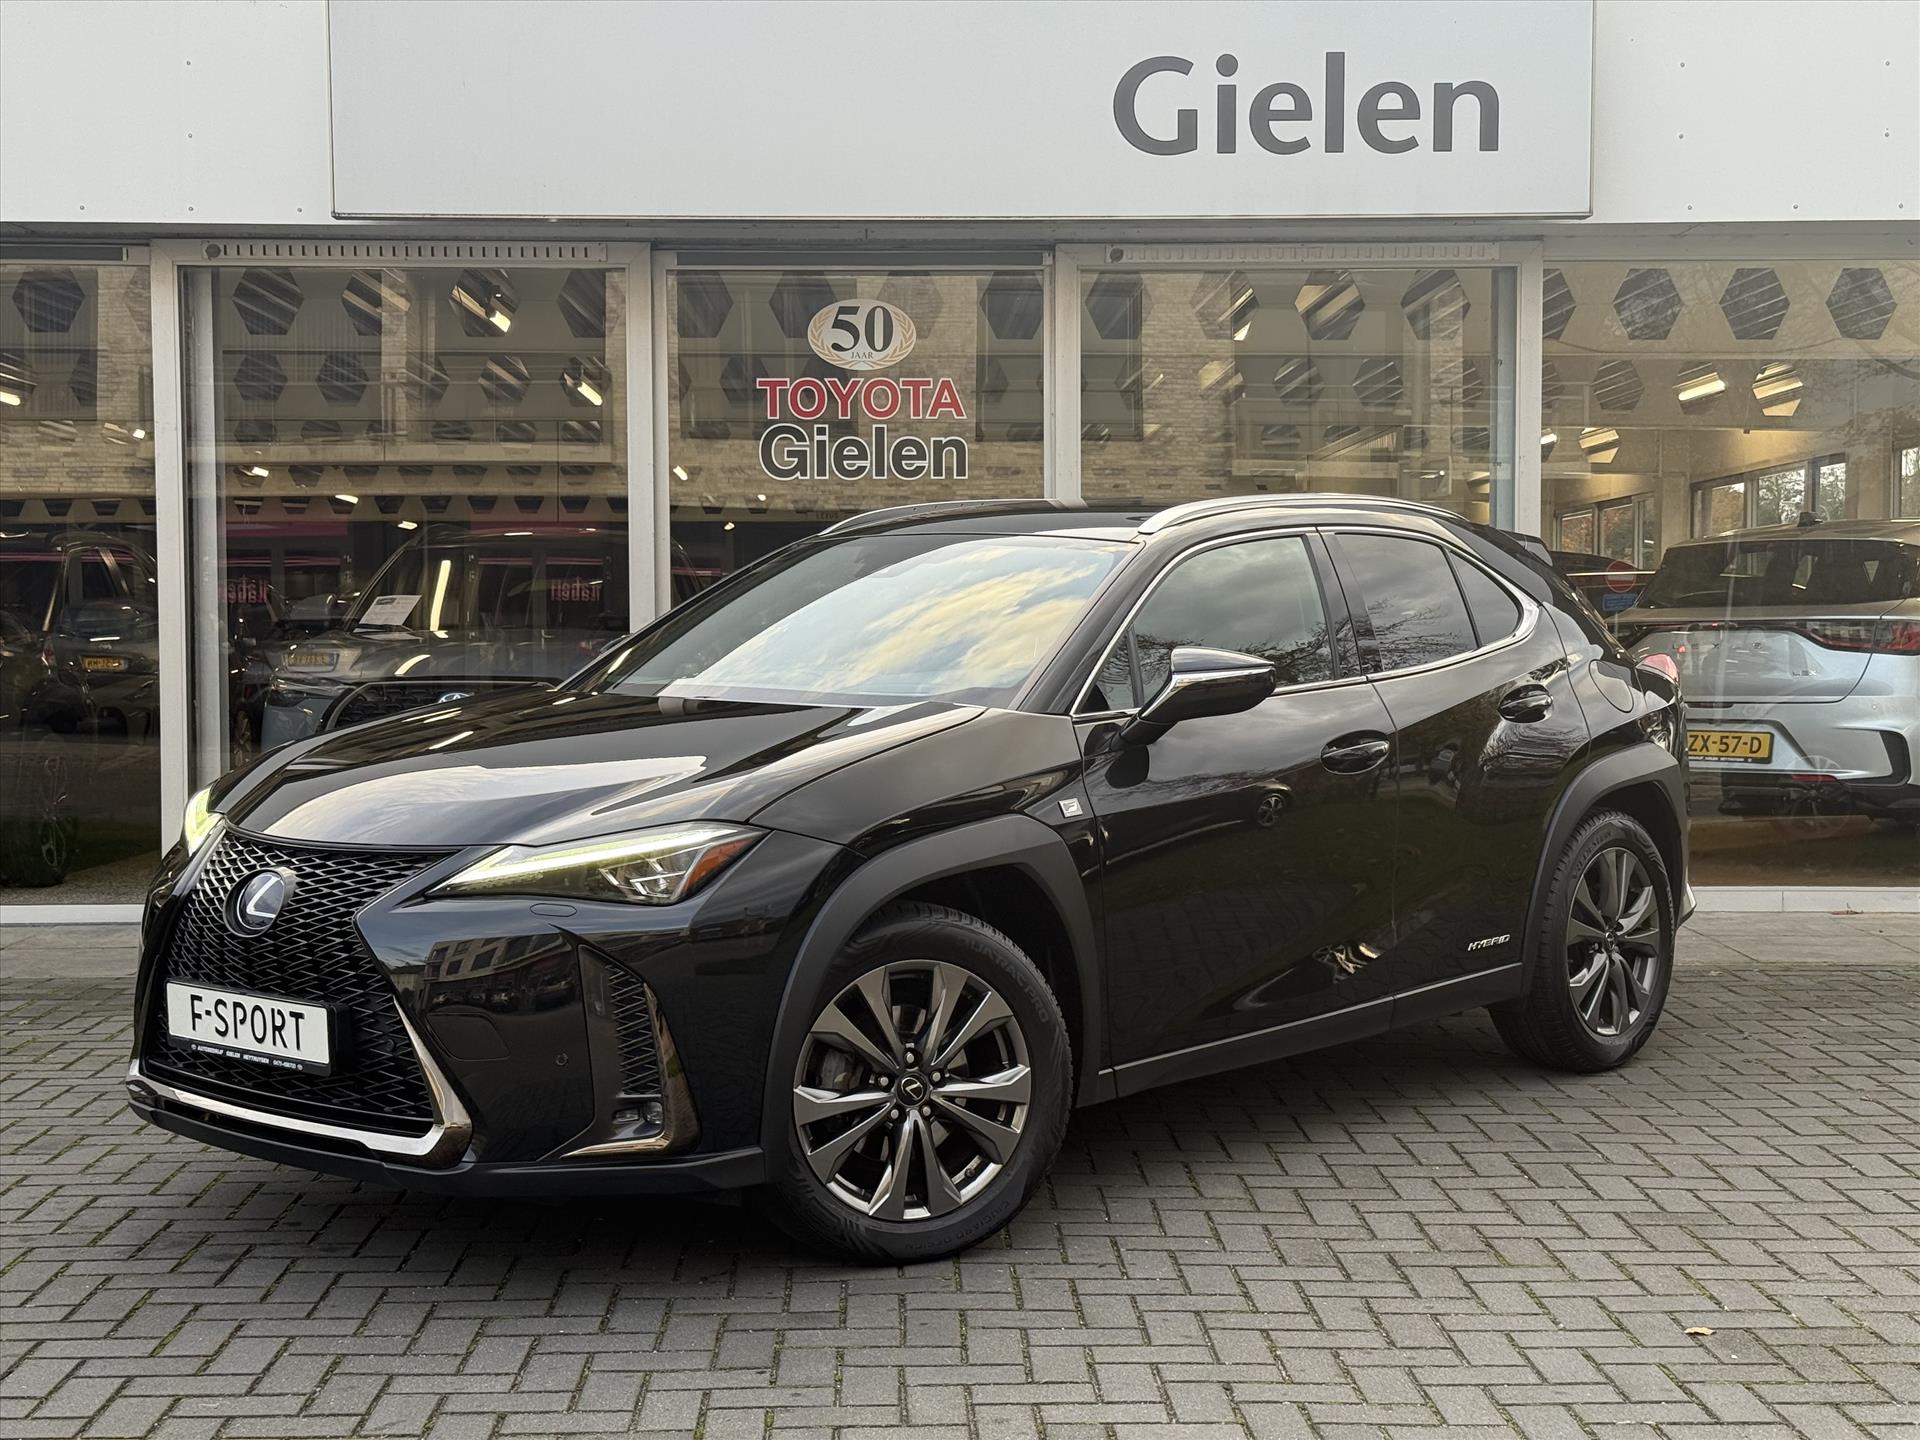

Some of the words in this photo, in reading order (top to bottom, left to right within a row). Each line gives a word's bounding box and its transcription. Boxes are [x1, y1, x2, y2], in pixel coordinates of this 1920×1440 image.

[1112, 51, 1500, 156] Gielen
[831, 305, 894, 352] 50
[850, 351, 875, 360] JAAR
[756, 377, 968, 420] TOYOTA
[759, 423, 969, 481] Gielen
[1688, 734, 1762, 754] ZX-57-D
[1467, 934, 1511, 951] HYBRID
[189, 994, 305, 1050] F-SPORT
